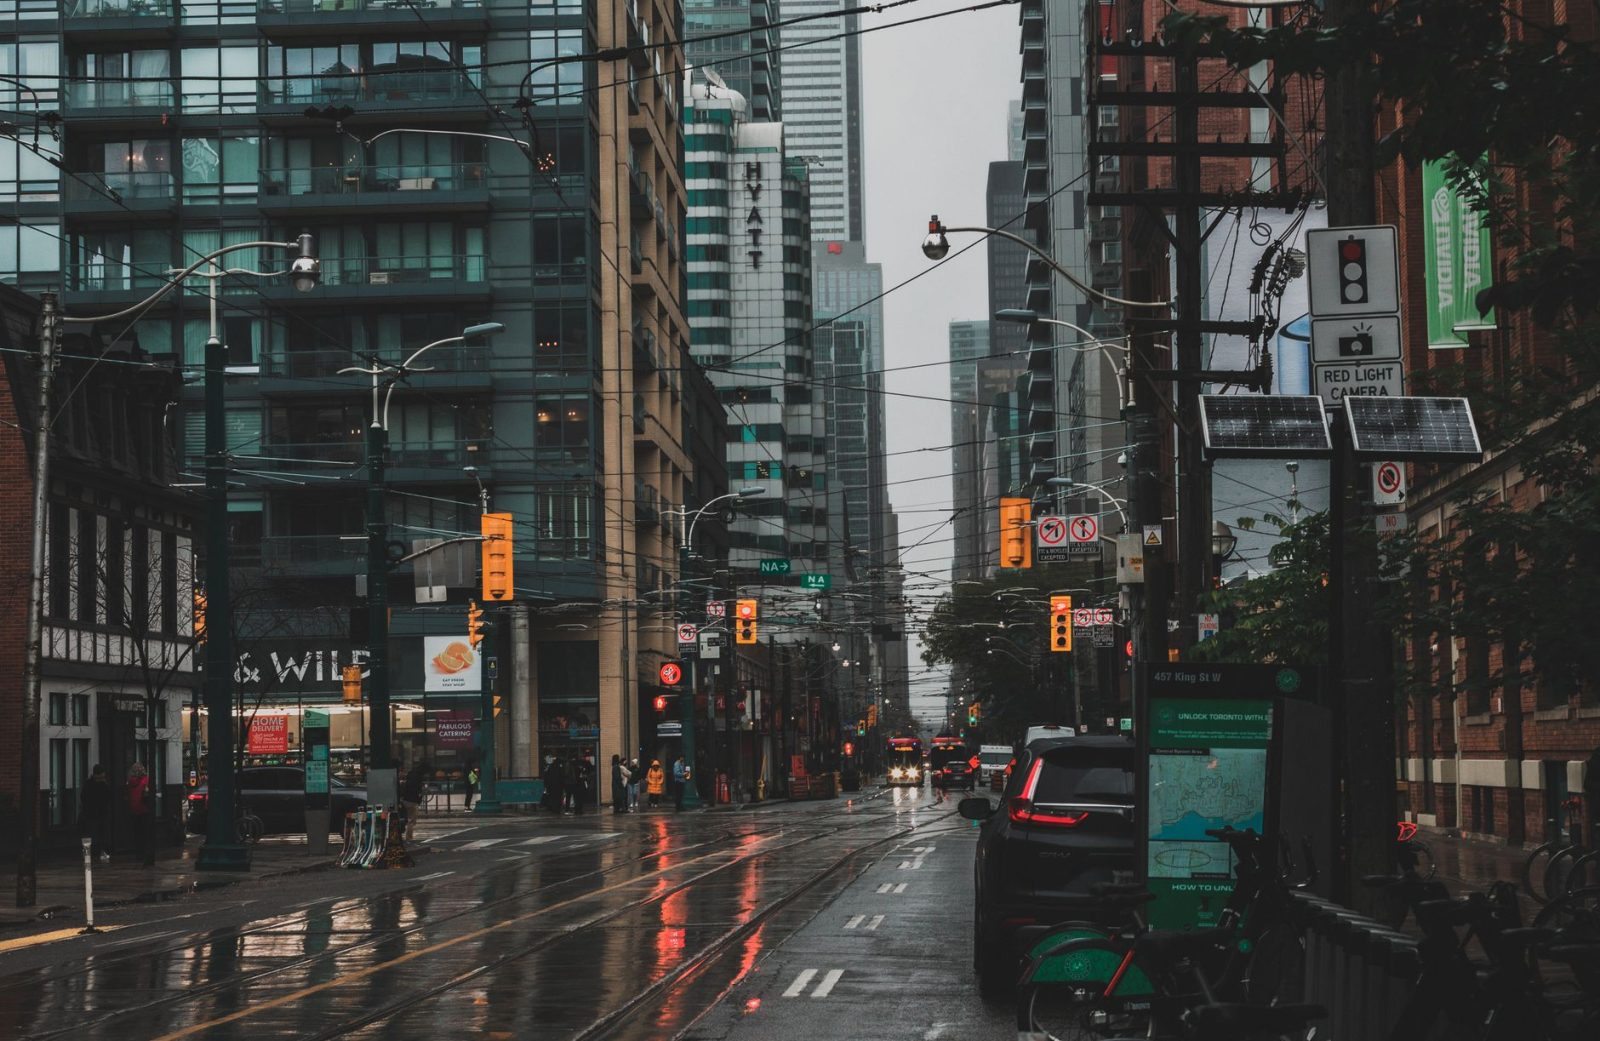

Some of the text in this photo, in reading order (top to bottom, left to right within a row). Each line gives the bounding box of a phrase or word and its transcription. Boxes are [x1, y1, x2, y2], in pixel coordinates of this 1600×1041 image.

[746, 161, 763, 269] HYATT
[1436, 226, 1454, 310] NVIDIA
[1324, 367, 1393, 383] RED LIGHT
[1331, 385, 1389, 400] CAMERA
[1385, 516, 1397, 527] NO
[761, 562, 779, 572] NA
[233, 651, 261, 684] &
[1154, 672, 1222, 683] 457 King St W
[252, 716, 285, 726] HOME
[1178, 712, 1264, 721] UNLOCK TORONTO WITH
